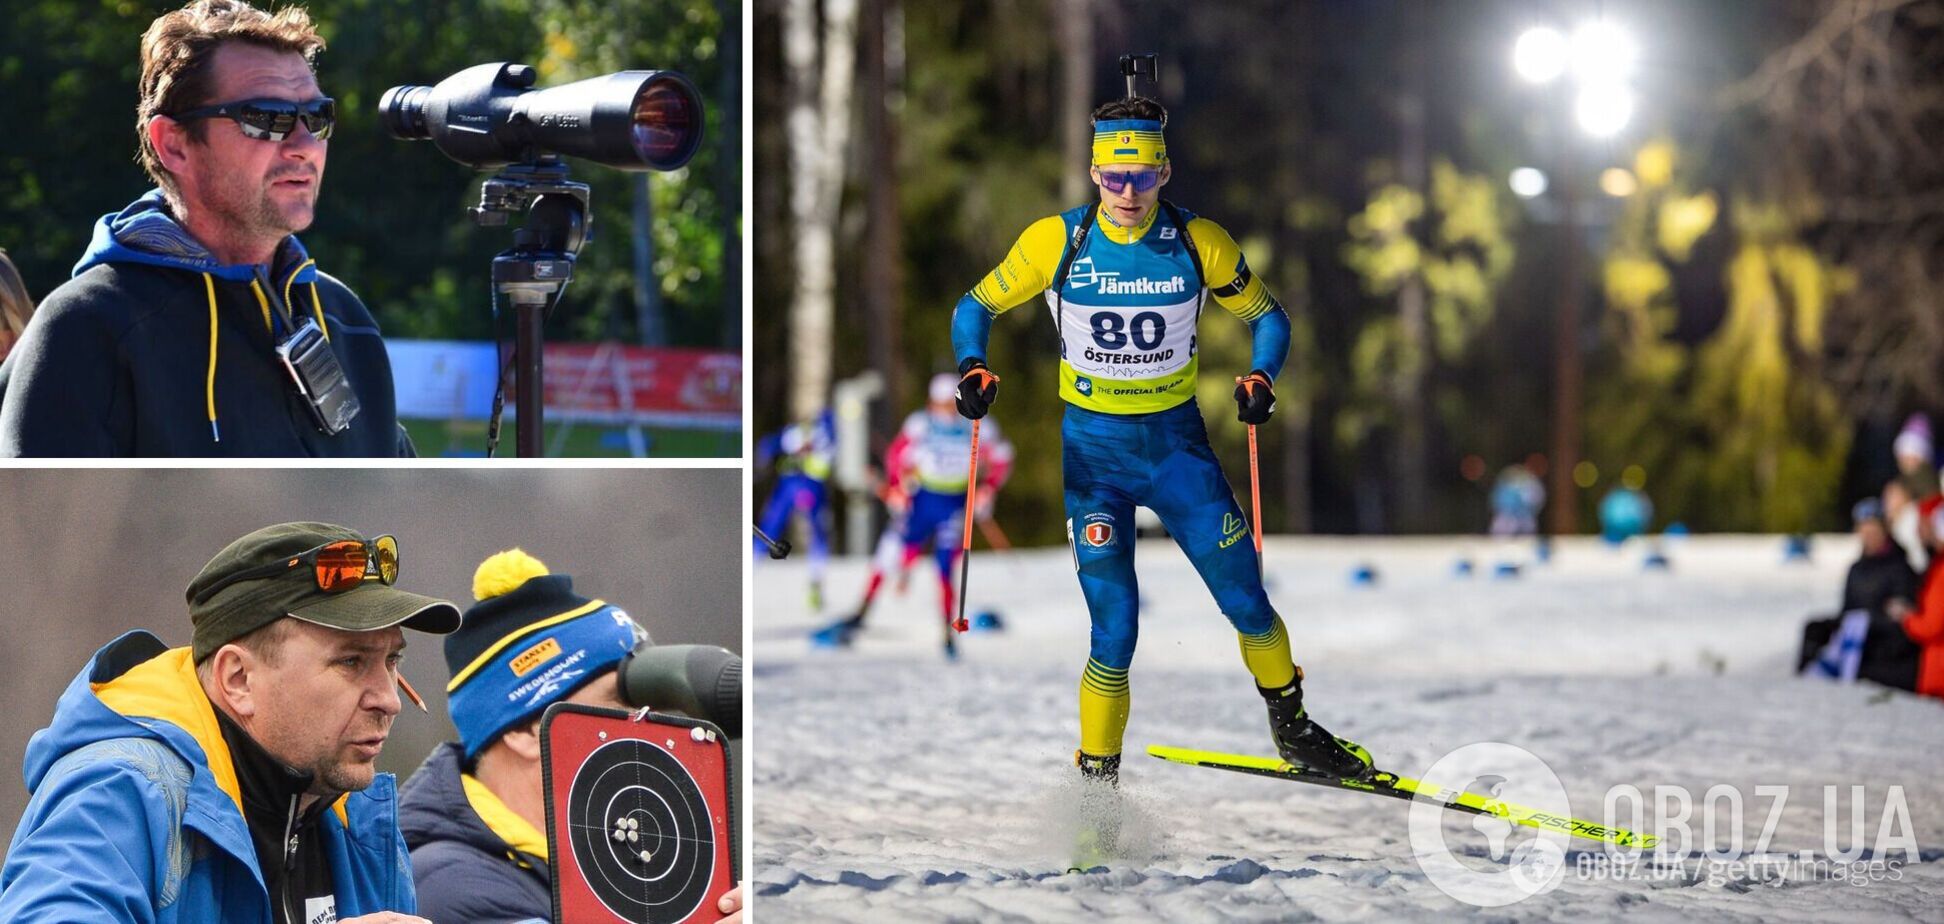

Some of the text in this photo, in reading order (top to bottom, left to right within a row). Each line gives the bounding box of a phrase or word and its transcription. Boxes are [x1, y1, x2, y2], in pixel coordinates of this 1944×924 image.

[1097, 276, 1185, 295] Jämtkraft
[1090, 311, 1166, 351] 80
[1084, 346, 1174, 365] ÖSTERSUND
[1097, 387, 1112, 395] THE
[1113, 388, 1154, 396] OFFICIAL
[1093, 526, 1105, 541] 1
[508, 649, 586, 702] SWEDEMOUNT
[1527, 812, 1621, 840] FISCHER
